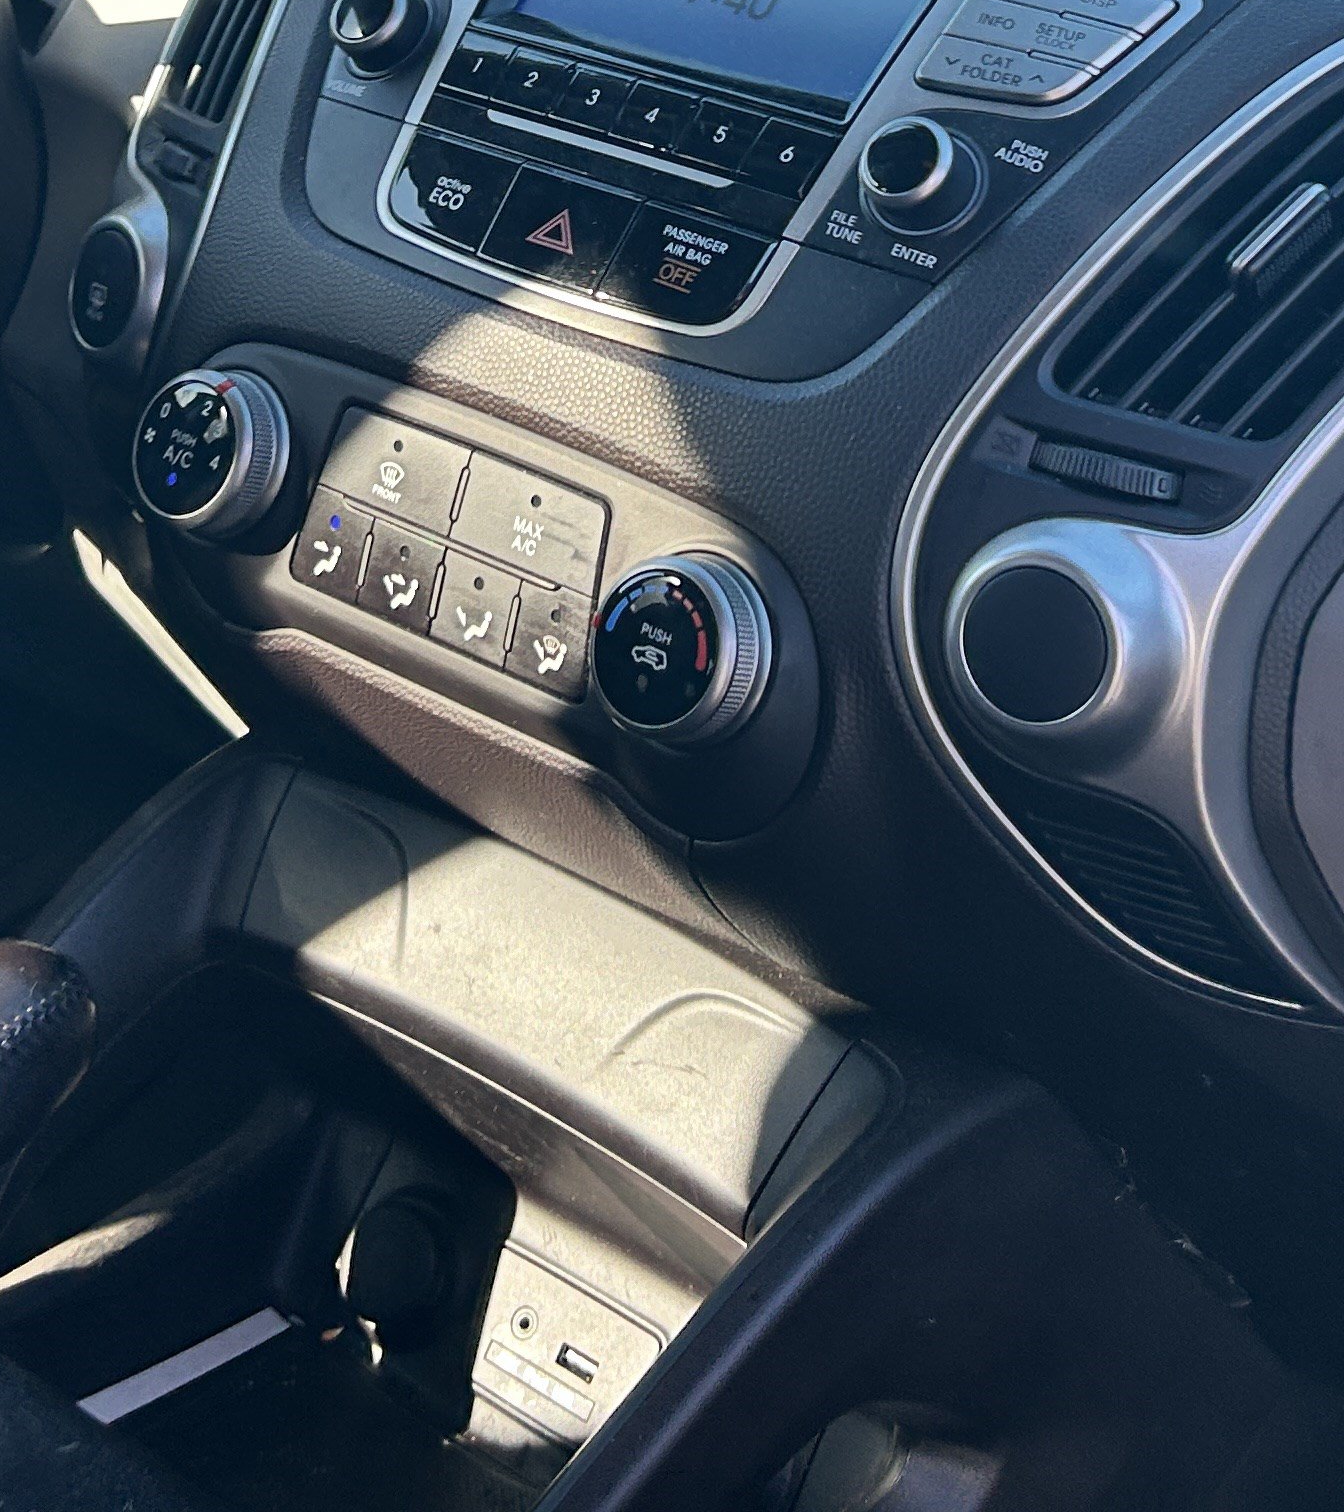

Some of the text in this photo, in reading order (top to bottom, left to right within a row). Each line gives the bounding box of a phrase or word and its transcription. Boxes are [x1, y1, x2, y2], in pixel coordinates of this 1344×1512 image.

[977, 12, 1016, 31] INFO
[1035, 22, 1086, 42] SETUP
[1034, 36, 1074, 51] CLOCK
[471, 57, 484, 73] 1
[981, 53, 1014, 69] CAT
[523, 71, 539, 88] 2
[960, 64, 1023, 87] FOLDER
[585, 89, 601, 106] 3
[644, 107, 660, 124] 4
[712, 125, 730, 143] 5
[779, 145, 795, 163] 6
[1010, 139, 1050, 160] PUSH
[994, 147, 1045, 173] AUDIO
[436, 176, 472, 195] active
[428, 186, 466, 211] ECO
[830, 209, 858, 227] FILE
[662, 224, 730, 256] PASSENGER
[825, 222, 864, 245] TUNE
[663, 242, 712, 266] AIR BAG
[890, 243, 938, 269] ENTER
[658, 262, 698, 287] OFF
[159, 402, 172, 419] 0
[200, 399, 213, 417] 2
[170, 428, 198, 448] PUSH
[162, 444, 194, 469] A/C
[208, 454, 221, 471] 4
[371, 483, 402, 504] FRONT
[512, 515, 545, 542] MAX
[511, 534, 537, 557] A/C
[639, 622, 673, 646] PUSH
